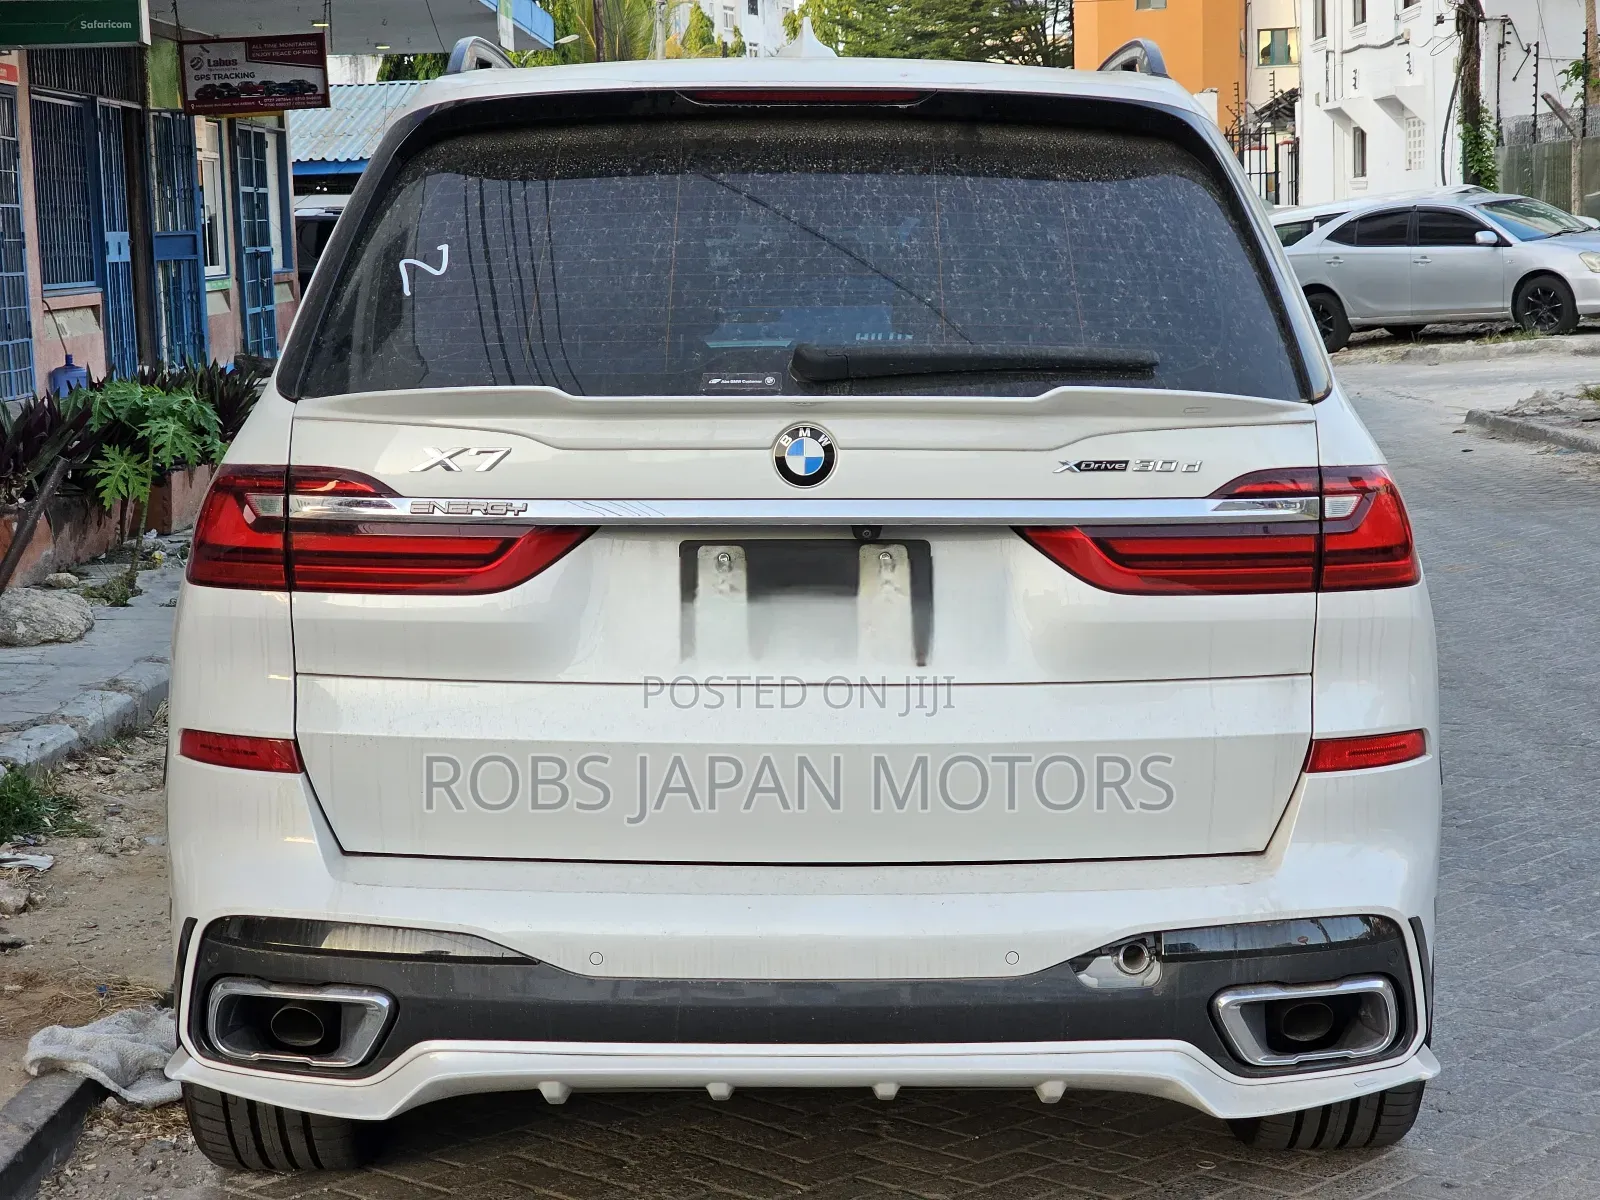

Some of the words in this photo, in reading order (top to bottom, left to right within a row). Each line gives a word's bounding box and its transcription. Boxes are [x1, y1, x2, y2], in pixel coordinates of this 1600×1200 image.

[80, 19, 132, 29] Safaricom
[194, 73, 211, 81] GPS
[213, 72, 255, 80] TRACKING
[780, 427, 831, 447] BMW
[409, 446, 512, 472] X7
[410, 500, 528, 516] ENERGY
